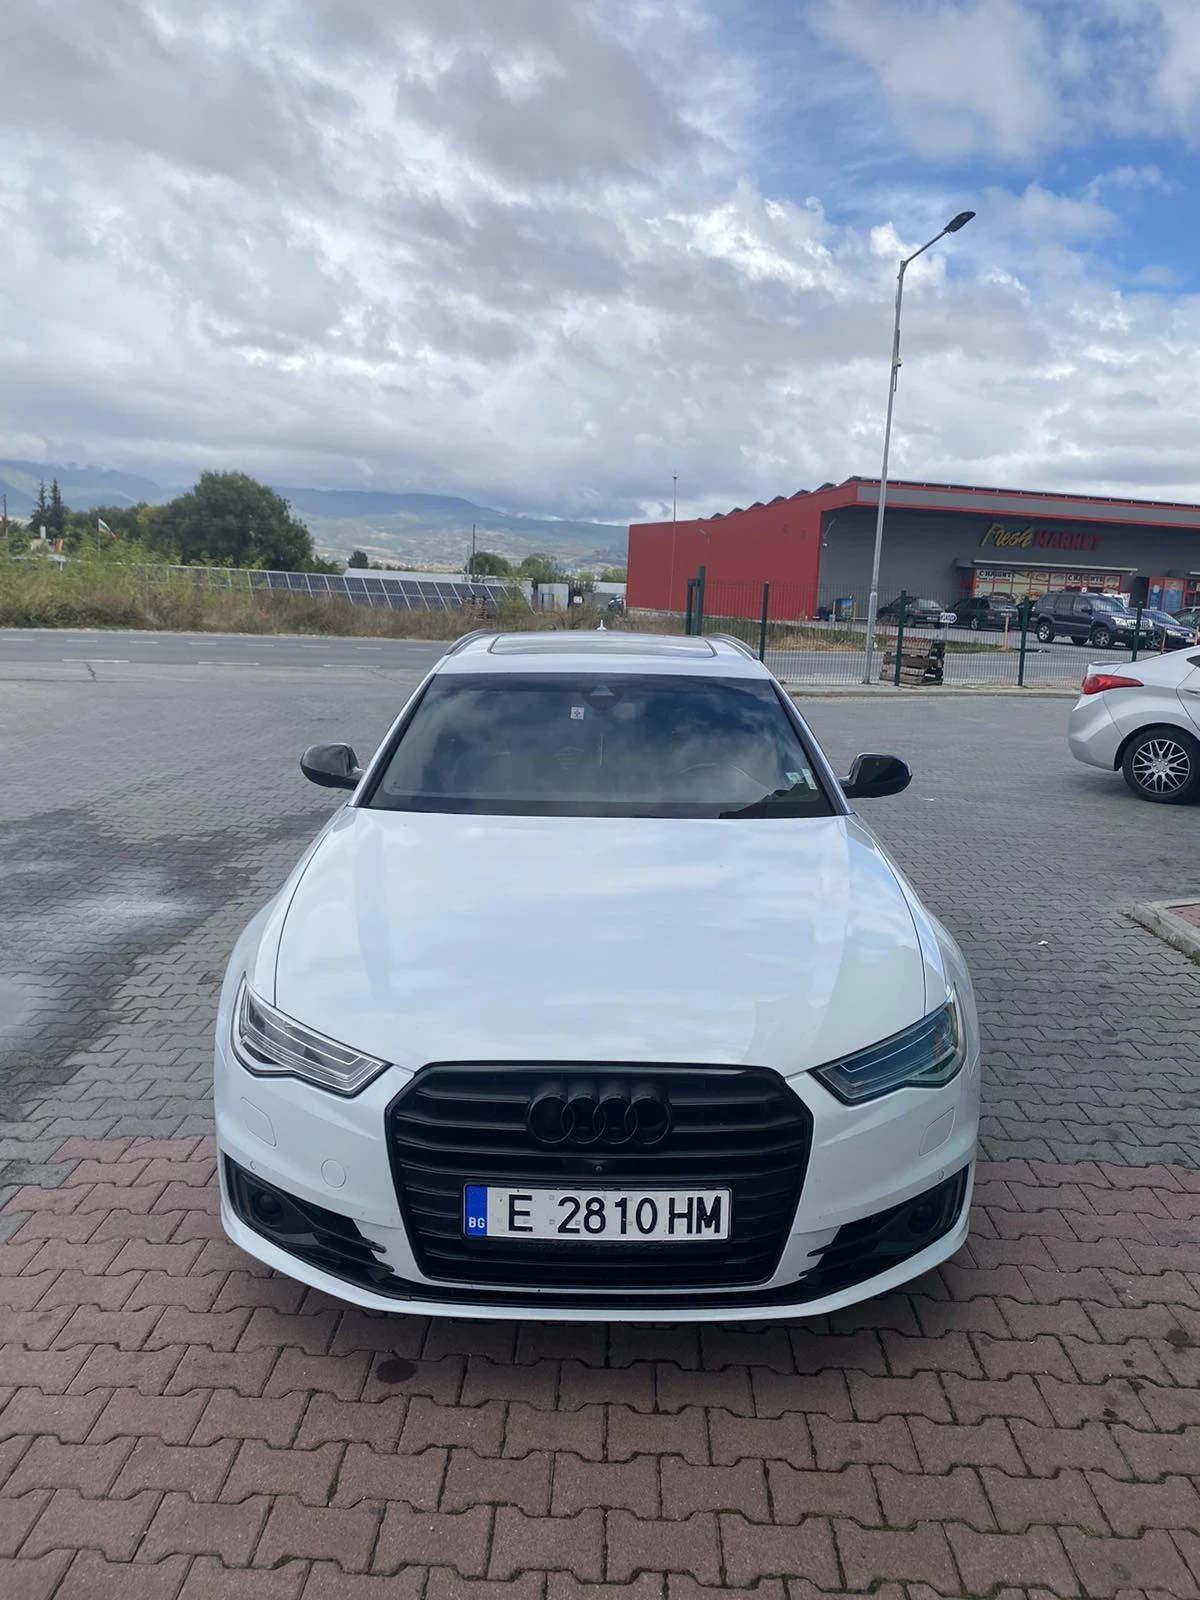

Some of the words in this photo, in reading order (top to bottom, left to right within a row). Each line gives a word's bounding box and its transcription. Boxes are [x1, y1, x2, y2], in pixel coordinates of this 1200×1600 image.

[980, 522, 1033, 548] Fresh
[1036, 530, 1104, 551] MARKET
[468, 1217, 485, 1229] BG
[508, 1194, 534, 1233] E
[557, 1196, 658, 1235] 2810
[668, 1195, 722, 1235] HM
